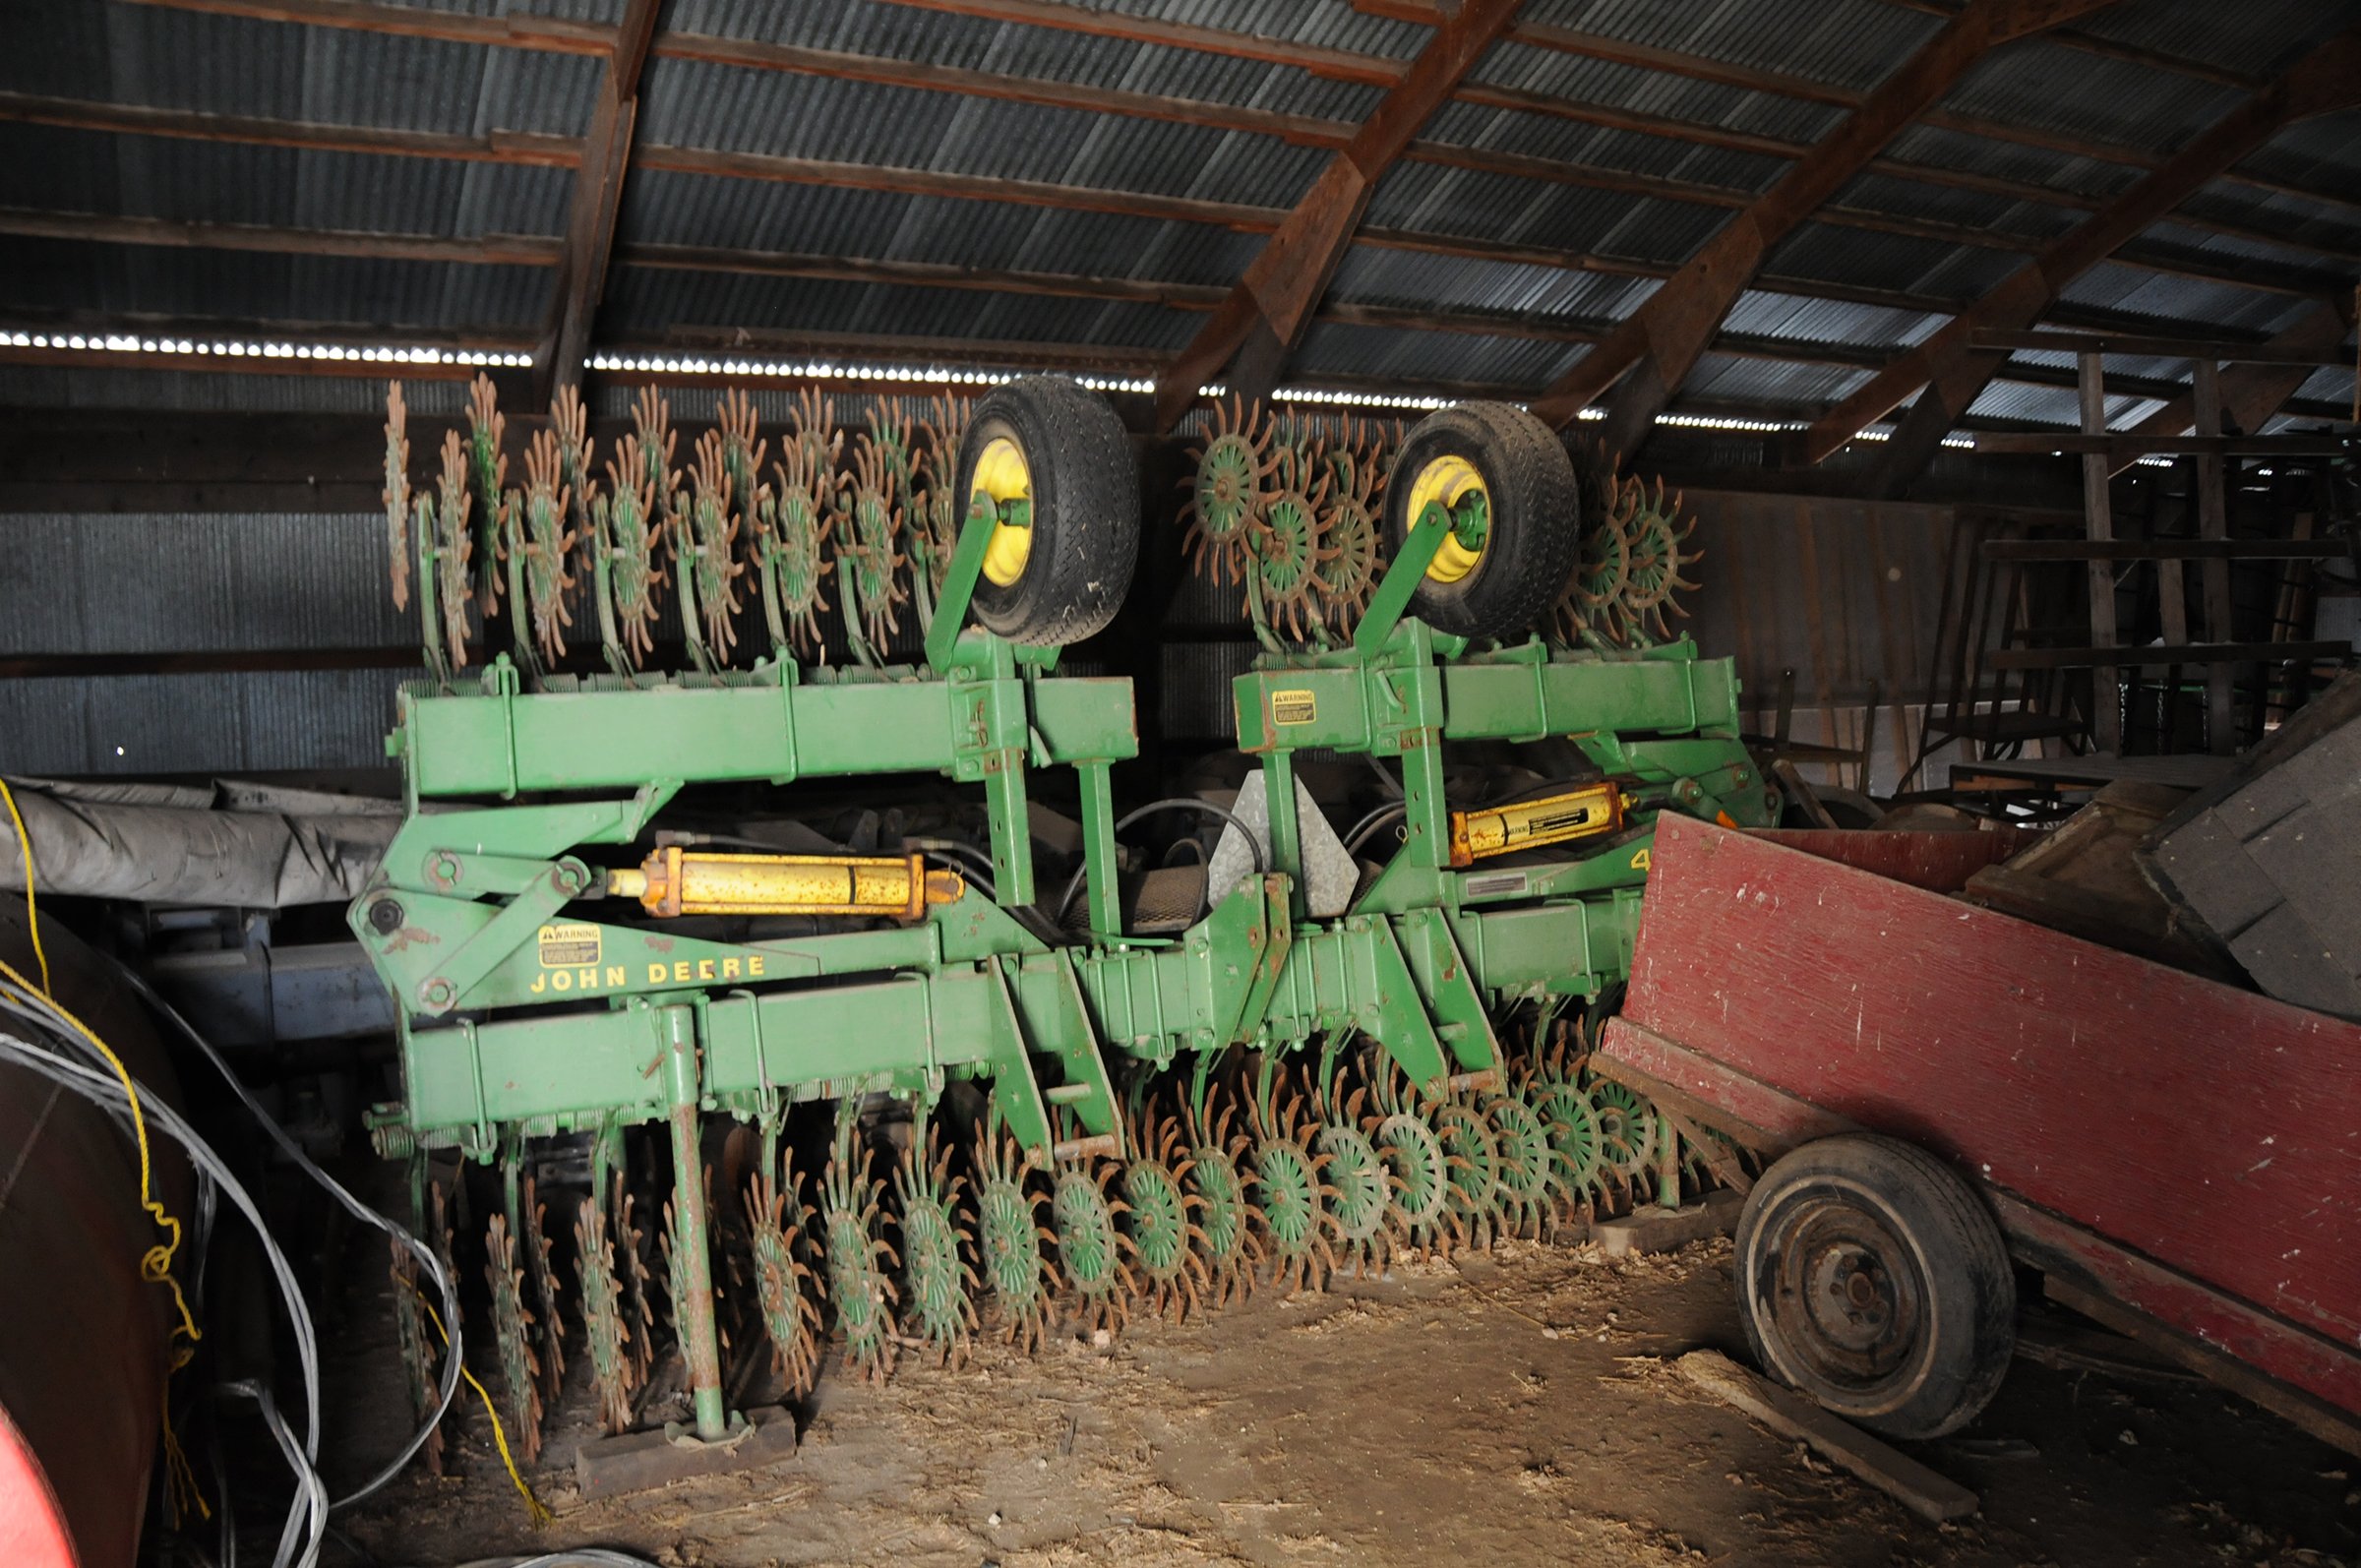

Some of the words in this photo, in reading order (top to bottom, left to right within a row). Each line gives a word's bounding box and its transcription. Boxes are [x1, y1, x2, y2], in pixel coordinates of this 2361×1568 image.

[556, 929, 598, 940] WARNING
[530, 965, 626, 994] JOHN
[648, 955, 764, 985] DEERE
